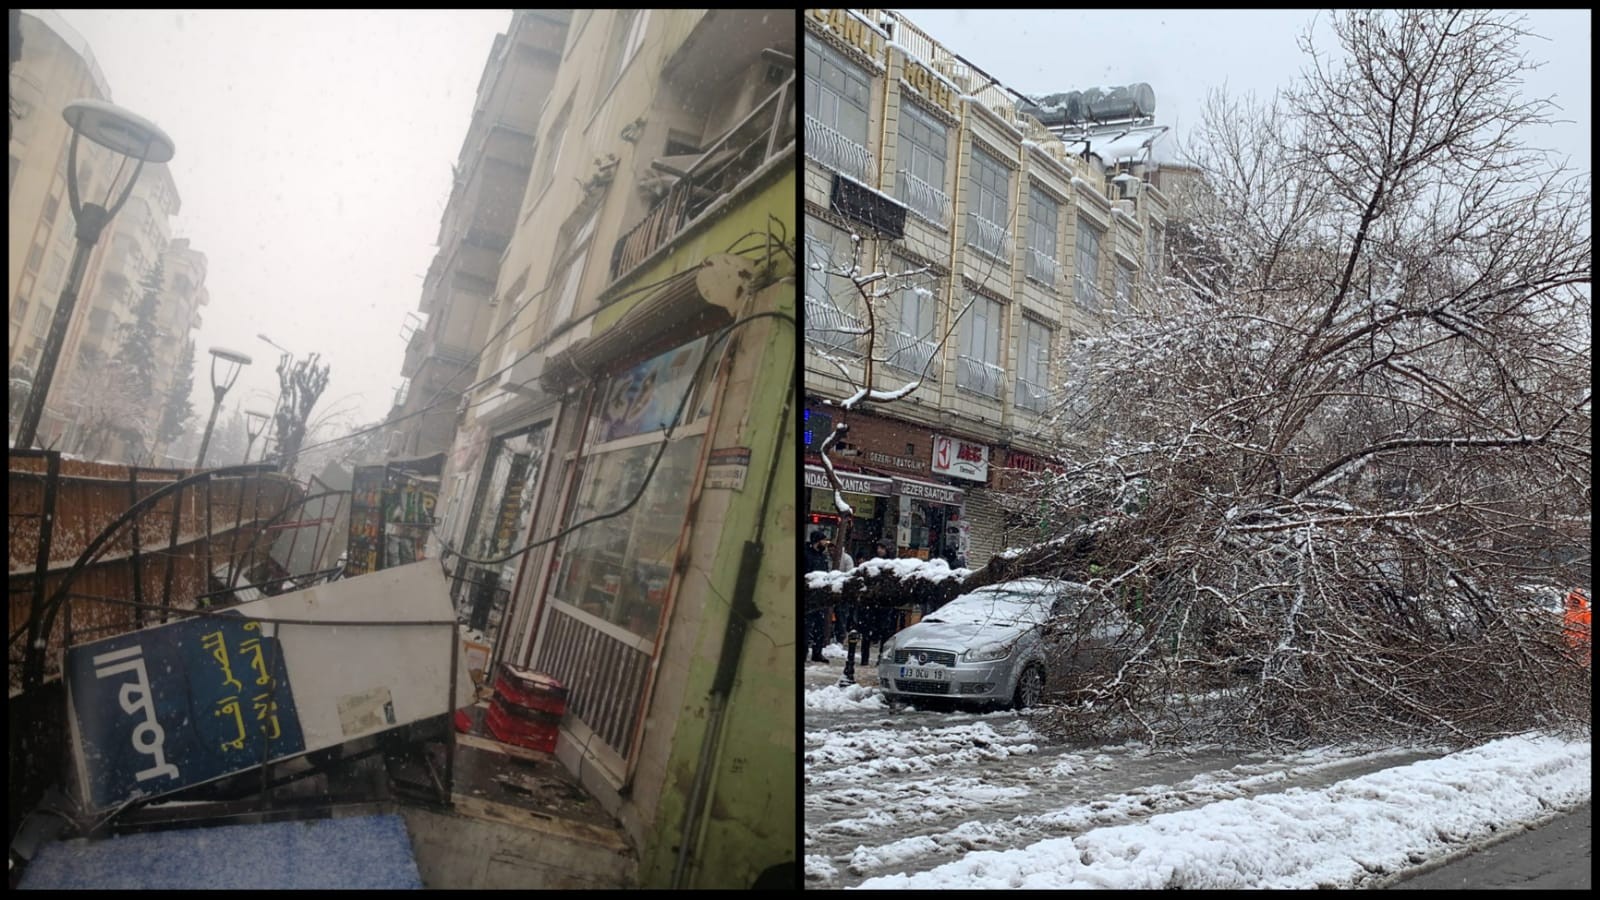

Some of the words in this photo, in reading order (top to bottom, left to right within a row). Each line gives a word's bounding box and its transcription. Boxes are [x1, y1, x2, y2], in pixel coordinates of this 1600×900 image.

[903, 61, 956, 114] HOTEL
[829, 475, 871, 493] KANTASI
[901, 483, 923, 496] GEZER
[93, 645, 180, 782] العمر
